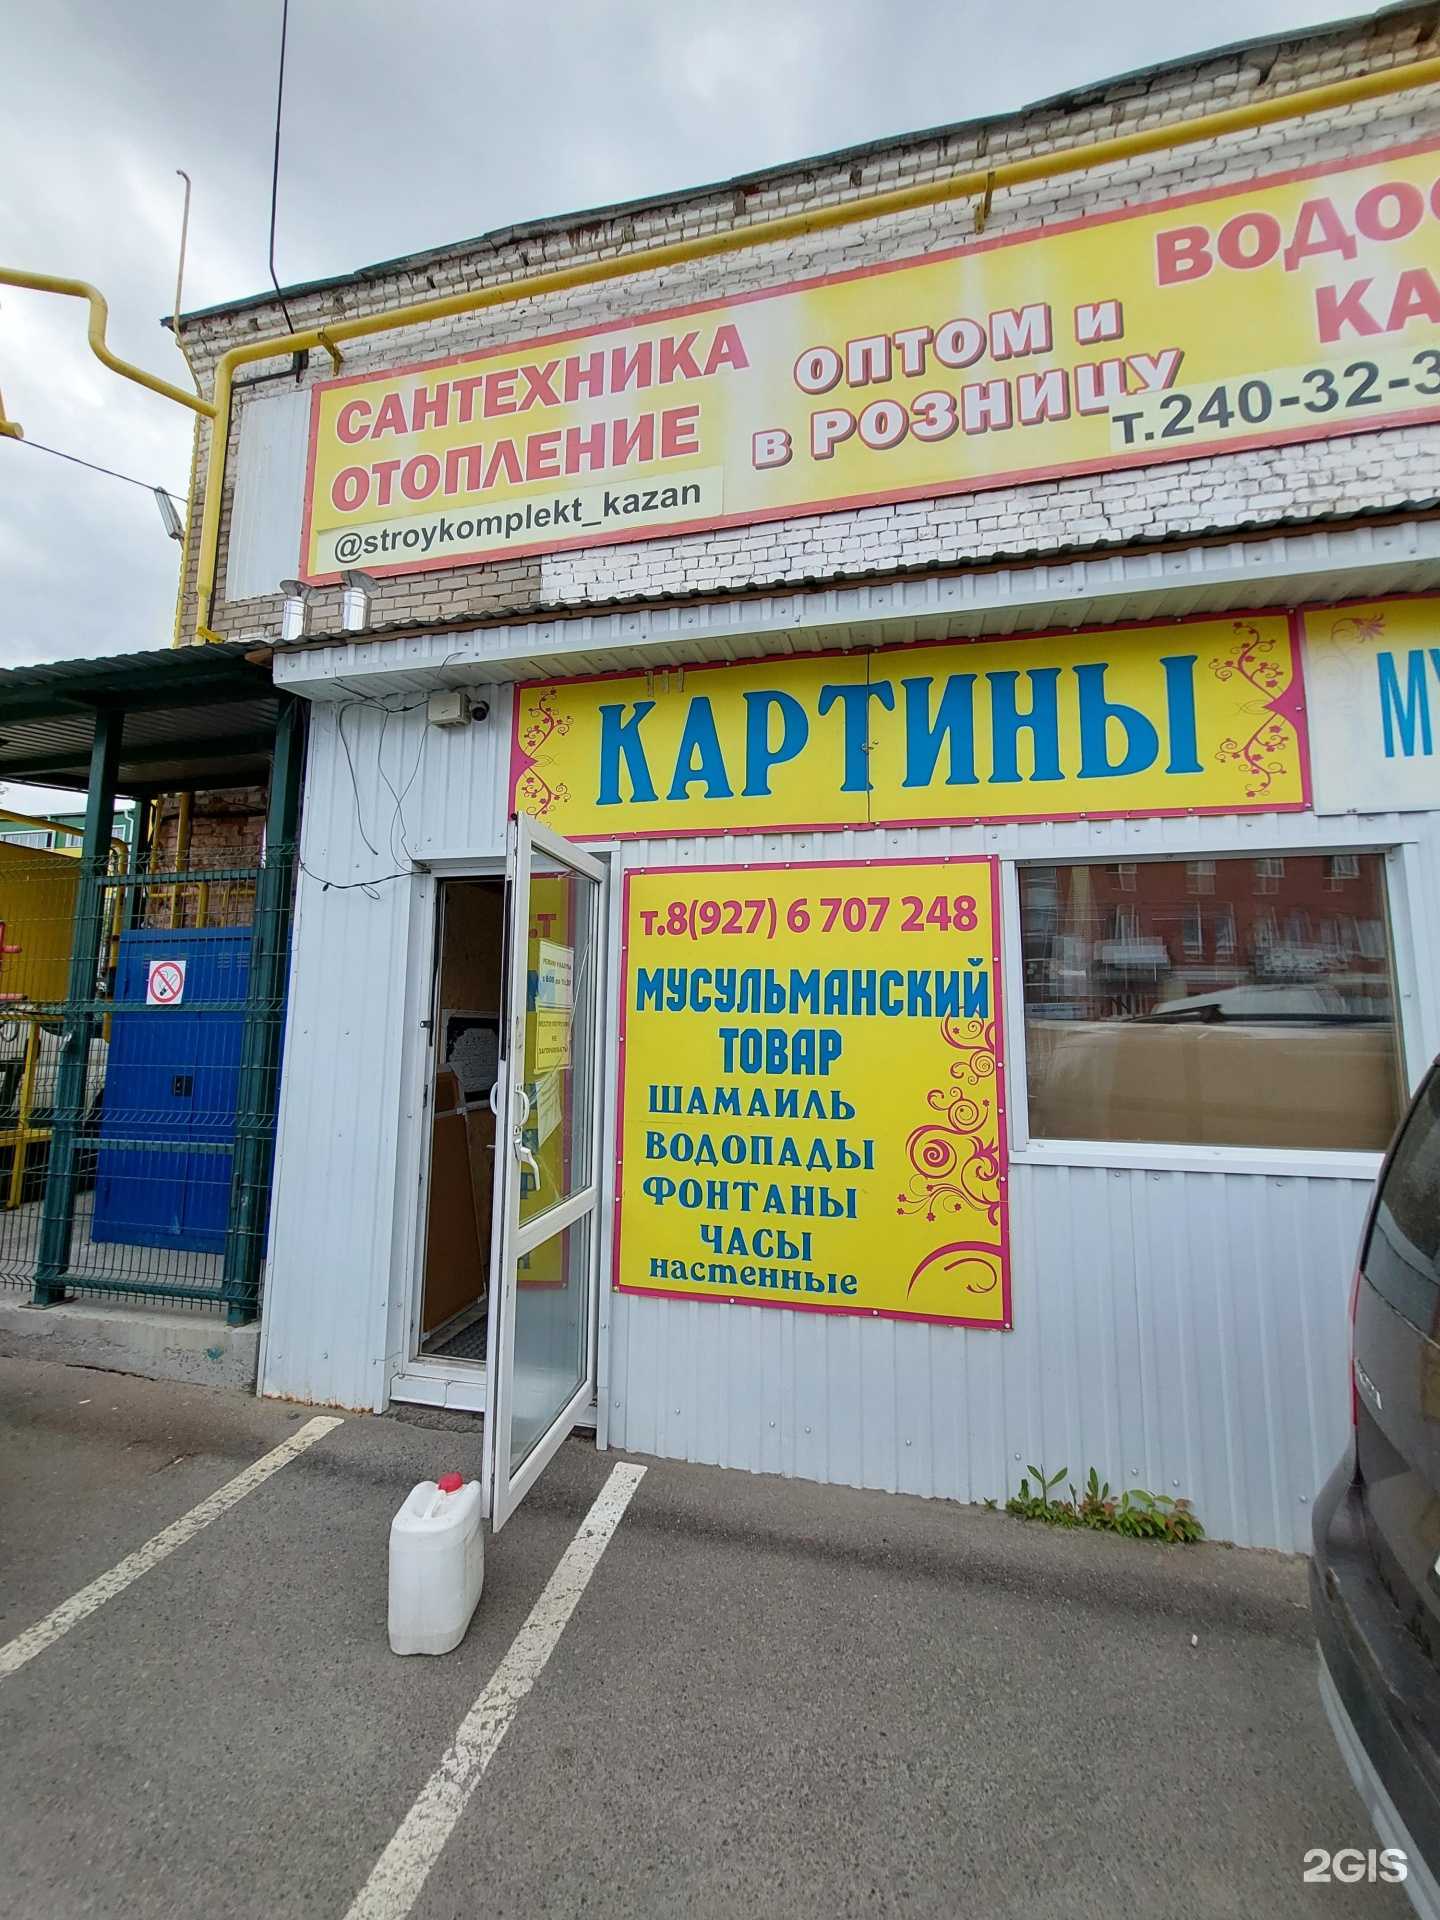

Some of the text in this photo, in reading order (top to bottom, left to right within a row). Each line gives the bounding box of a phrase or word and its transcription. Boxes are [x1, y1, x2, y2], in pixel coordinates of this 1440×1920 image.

[1156, 180, 1440, 286] ВОДО
[793, 302, 1053, 394] ОПТОМ
[336, 324, 750, 445] САНТЕХНИКА
[810, 347, 1185, 460] РОЗНИЦУ
[331, 404, 701, 512] ОТОПЛЕНИЕ
[334, 482, 701, 564] @stroykomplekt_kazan
[595, 653, 1204, 805] КАРТИНЫ
[1376, 648, 1440, 758] М
[640, 895, 979, 940] т.8(927) 6 707 248
[635, 957, 990, 1019] МУСУЛЬМАНСКИЙ
[718, 1027, 843, 1077] ТОВАР
[648, 1084, 856, 1121] ШАМАИЛЬ
[644, 1130, 875, 1172] ВОДОПАДЫ
[641, 1175, 859, 1219] ФОНТАНЫ
[649, 1256, 859, 1296] настенные
[700, 1223, 813, 1262] ЧАСЫ
